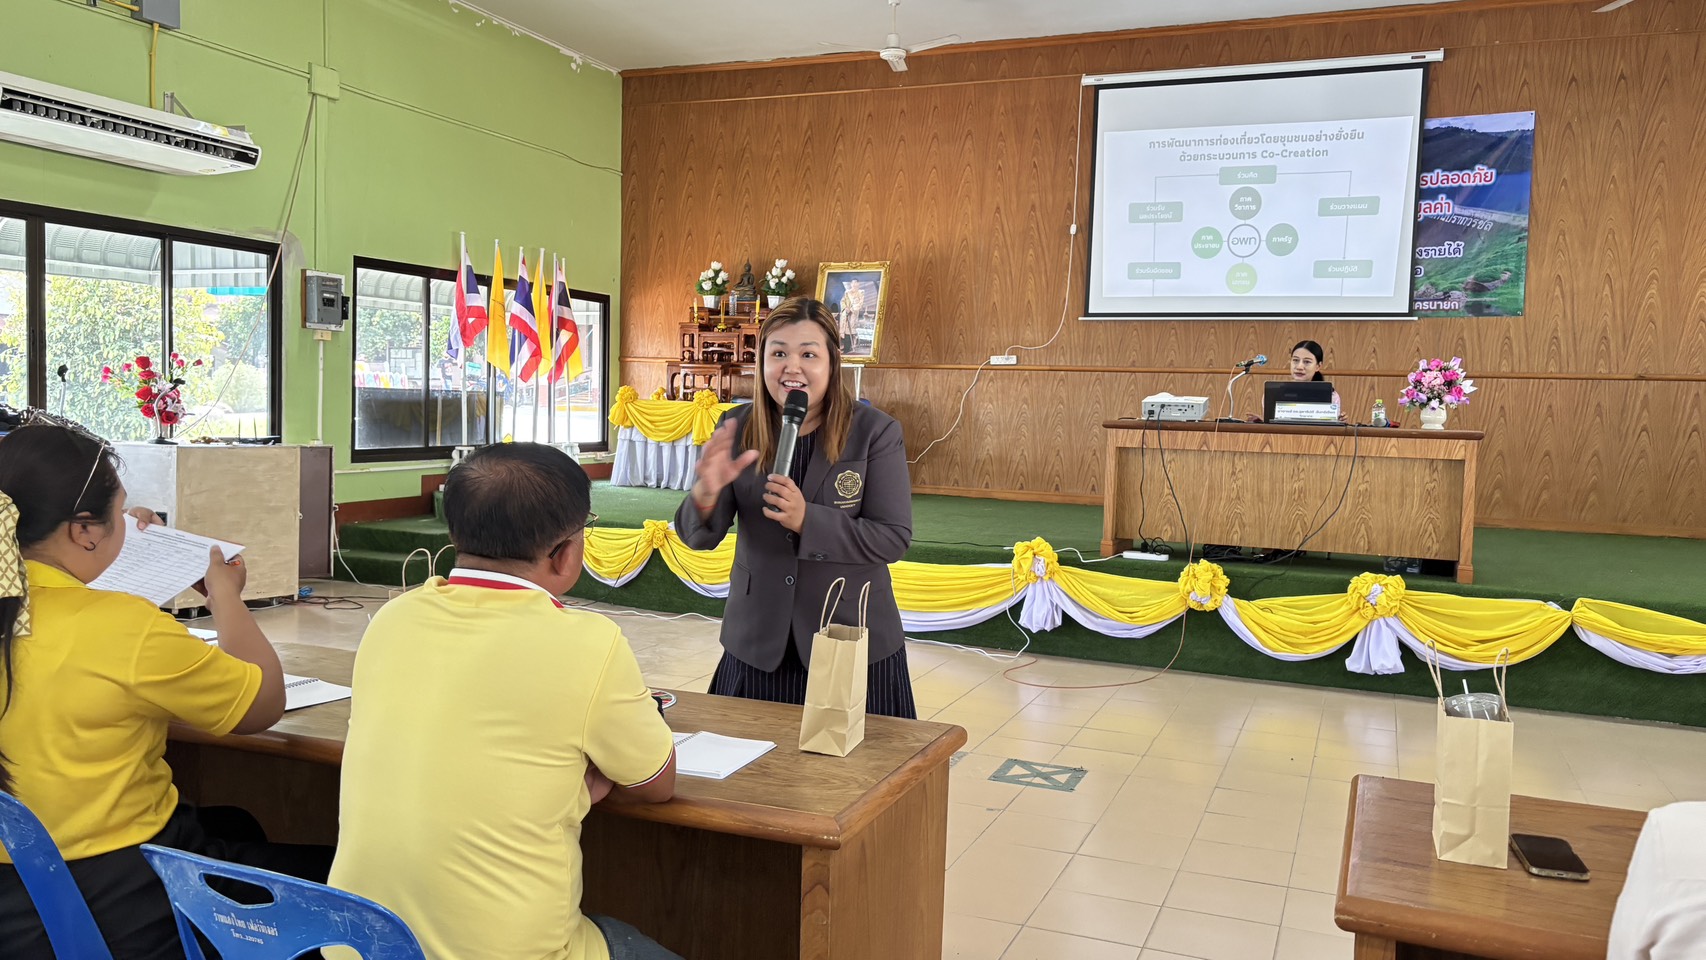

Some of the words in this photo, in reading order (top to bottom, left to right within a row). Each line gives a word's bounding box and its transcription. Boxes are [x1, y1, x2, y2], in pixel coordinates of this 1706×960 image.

[1149, 128, 1364, 149] การพัฒนาการท่องเที่ยวโดยชุมชนอย่างยั่งยืน
[1179, 151, 1257, 162] ด้วยกระบวนการ
[1261, 148, 1329, 159] Co-Creation
[1413, 301, 1459, 310] ครนายก
